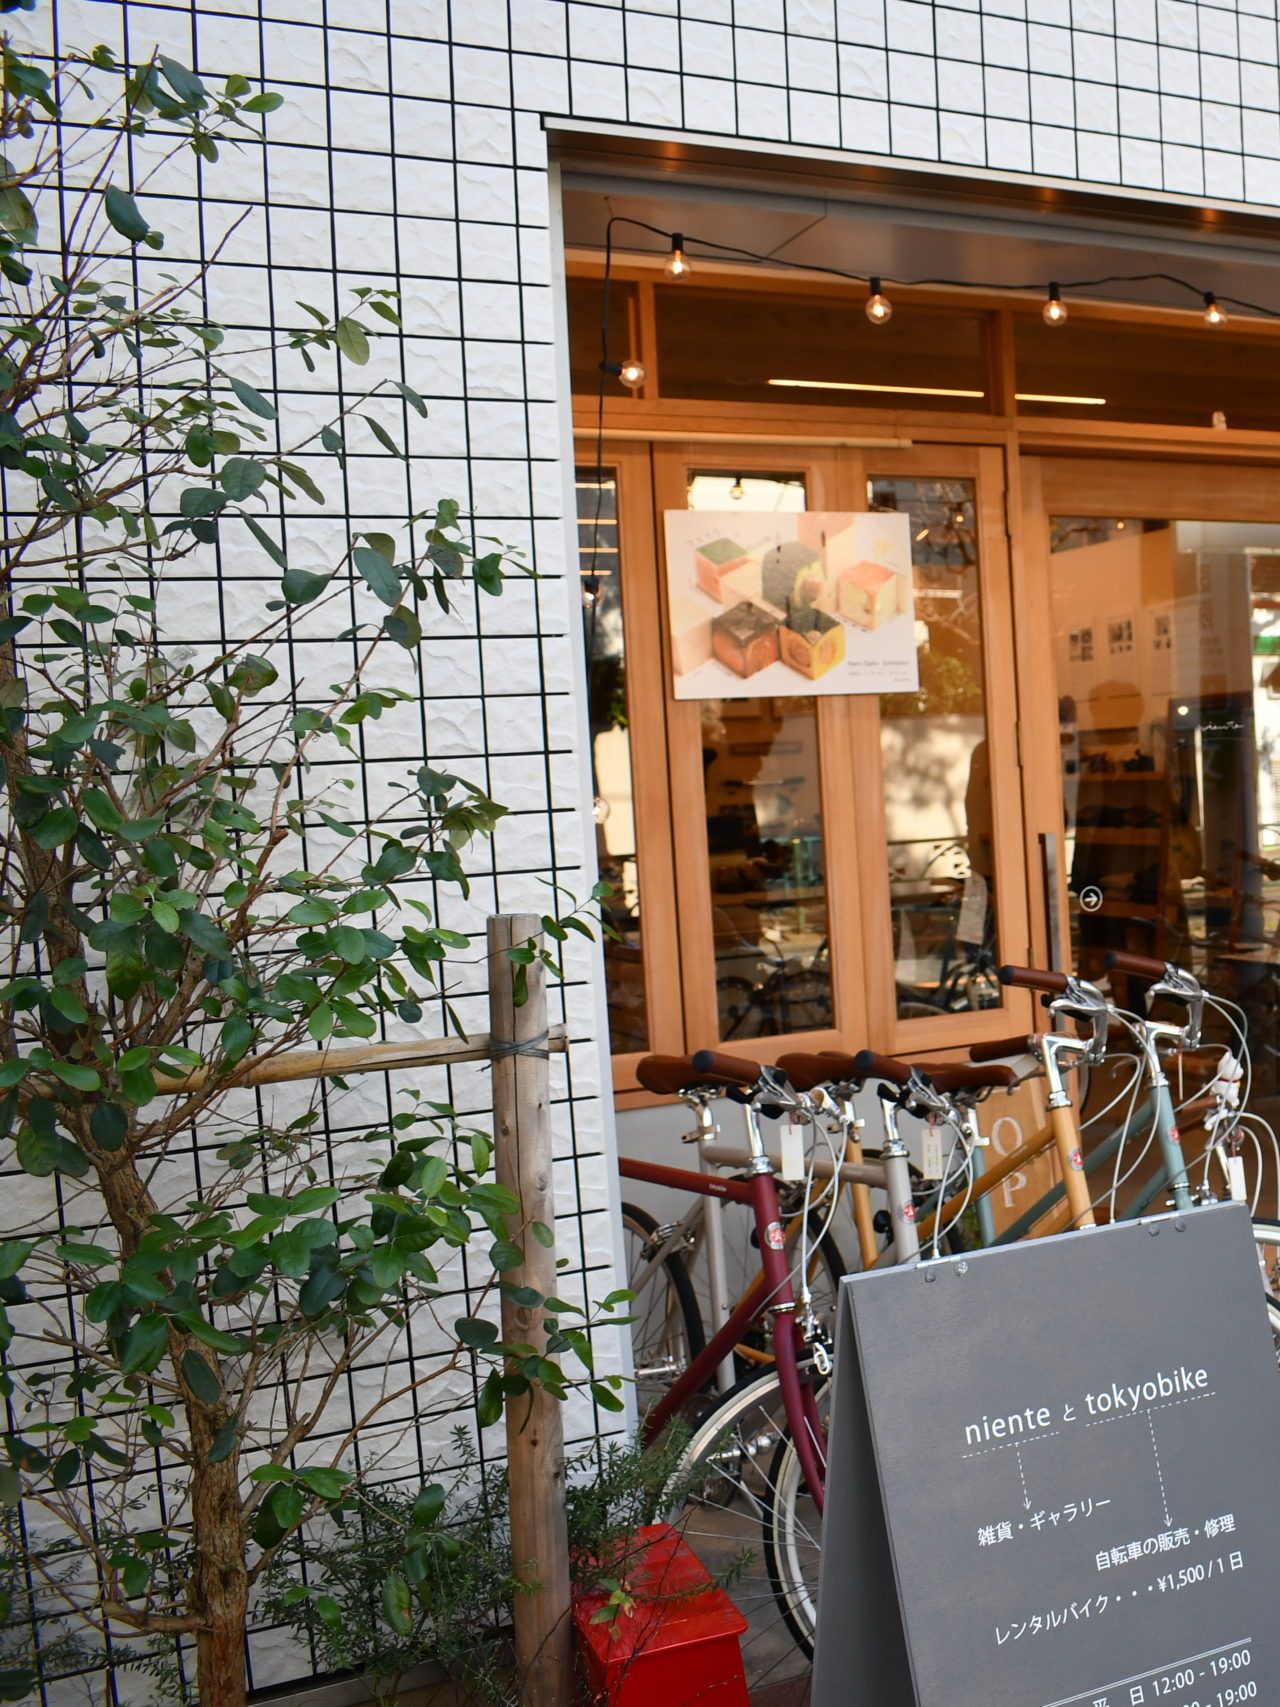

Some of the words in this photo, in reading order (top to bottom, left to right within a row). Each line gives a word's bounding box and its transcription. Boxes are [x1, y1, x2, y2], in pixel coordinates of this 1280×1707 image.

[965, 1407, 1051, 1445] niente
[1063, 1404, 1077, 1422] と
[1085, 1366, 1209, 1415] tokyobike
[1152, 1669, 1195, 1696] 12:00
[1210, 1649, 1251, 1677] 19:00
[1216, 1681, 1257, 1707] 19:00
